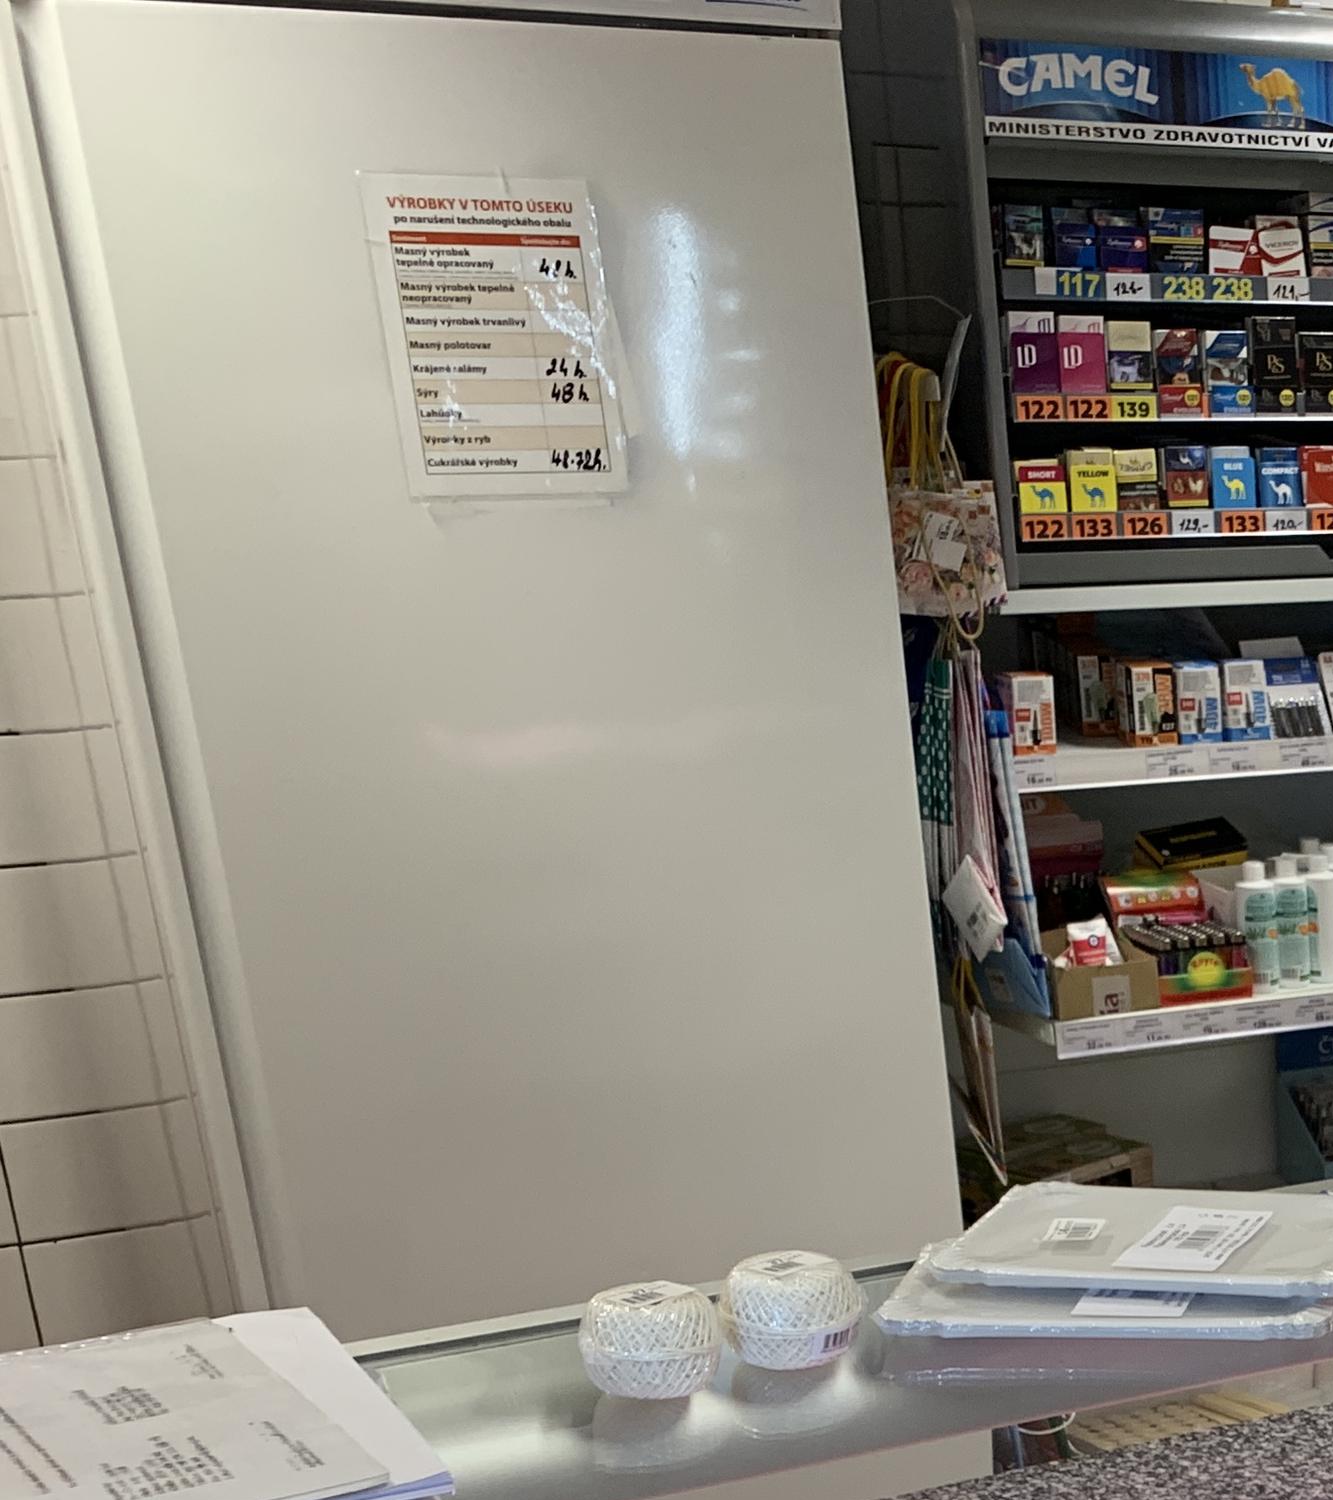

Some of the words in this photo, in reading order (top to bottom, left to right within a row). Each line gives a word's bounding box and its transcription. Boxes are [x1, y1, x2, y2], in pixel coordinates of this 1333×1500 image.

[999, 53, 1159, 104] CAMEL
[989, 121, 1145, 140] MINISTERSTVO
[1154, 129, 1310, 148] ZDRAVOTNICTVÍ
[387, 194, 455, 211] VÝROBKY
[459, 198, 469, 210] V
[472, 199, 522, 212] TOMTO
[527, 198, 572, 213] ÚSEKU
[394, 216, 406, 224] po
[410, 213, 454, 224] narušení
[457, 215, 540, 228] technologického
[543, 219, 571, 228] obalu
[395, 247, 426, 258] Masný
[429, 247, 470, 257] výrobek
[396, 258, 434, 268] tepelně
[437, 259, 494, 269] opracovaný
[401, 282, 432, 293] Masný
[434, 282, 474, 293] výrobek
[478, 283, 515, 293] tepelně
[1060, 271, 1099, 297] 117
[1163, 277, 1204, 300] 238
[1212, 277, 1253, 301] 238
[402, 294, 472, 304] neopracovaný
[406, 317, 438, 328] Masný
[440, 317, 480, 327] výrobek
[482, 317, 526, 328] trvanlivý
[409, 340, 441, 351] Masný
[444, 340, 491, 350] polotovar
[546, 359, 568, 376] 24
[417, 388, 438, 399] Sýry
[552, 384, 574, 403] 48
[1020, 400, 1060, 420] 122
[1069, 400, 1108, 419] 122
[1118, 401, 1149, 418] 139
[475, 434, 491, 445] ryb
[478, 457, 517, 468] výrobky
[1223, 462, 1244, 471] BLUE
[1262, 466, 1299, 475] COMPACT
[1027, 470, 1055, 479] SHORT
[1025, 520, 1065, 539] 122
[1076, 519, 1113, 537] 133
[1128, 517, 1163, 535] 126
[1225, 515, 1260, 533] 133
